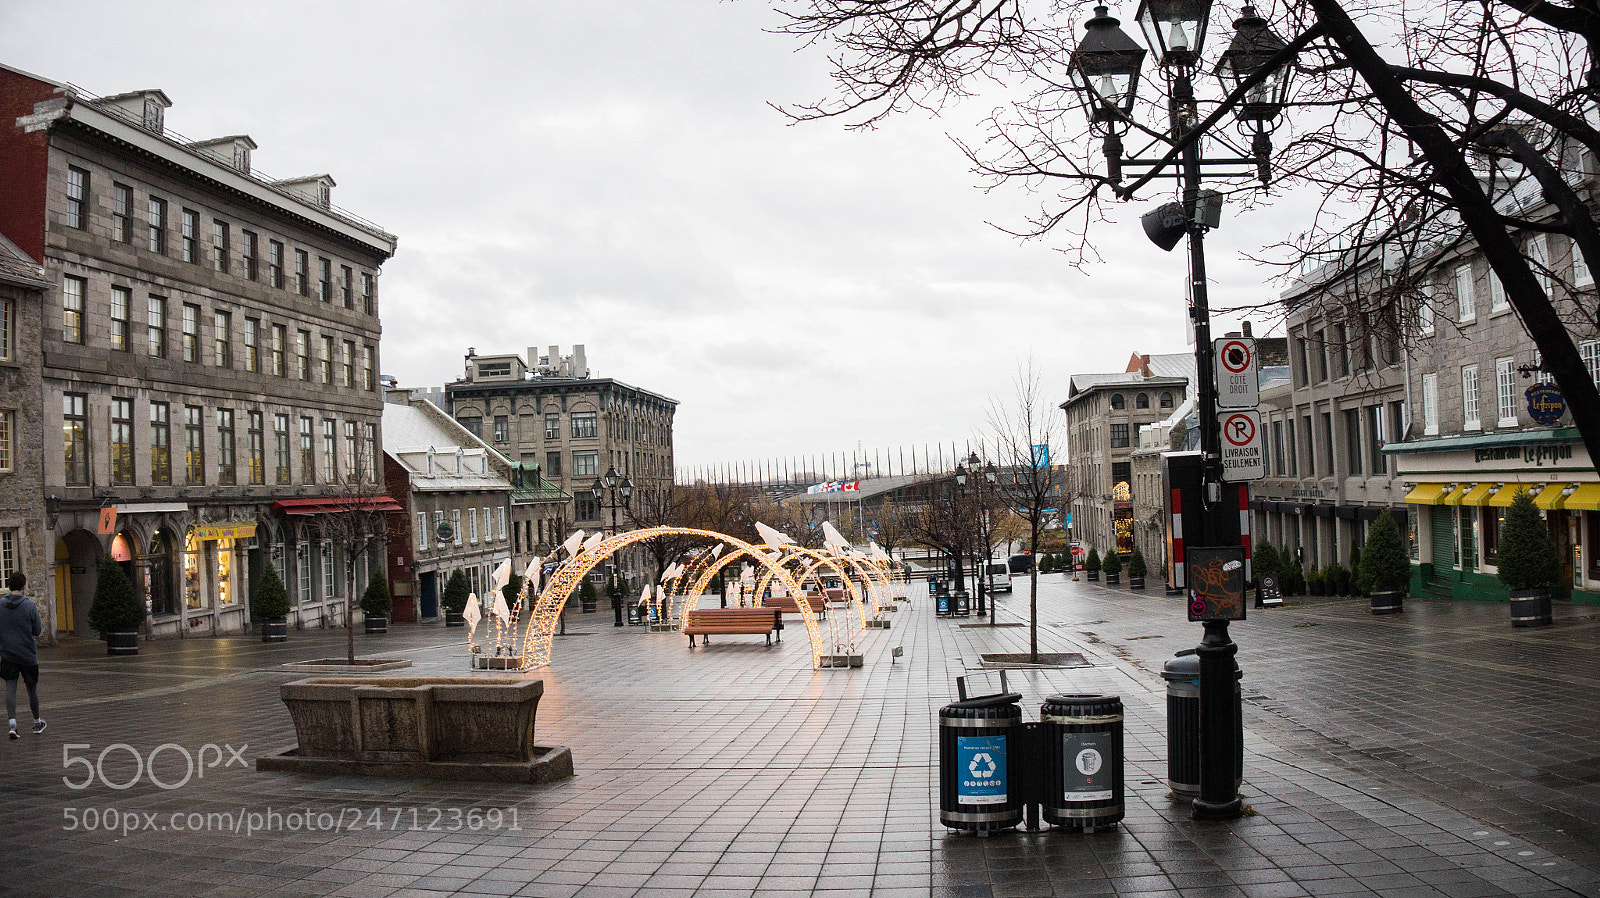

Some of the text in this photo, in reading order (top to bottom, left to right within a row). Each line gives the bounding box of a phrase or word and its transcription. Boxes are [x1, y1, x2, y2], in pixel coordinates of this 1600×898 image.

[1229, 384, 1248, 394] DROIT
[1224, 447, 1259, 458] LIVRAISON
[1224, 458, 1261, 469] SEULEMENT
